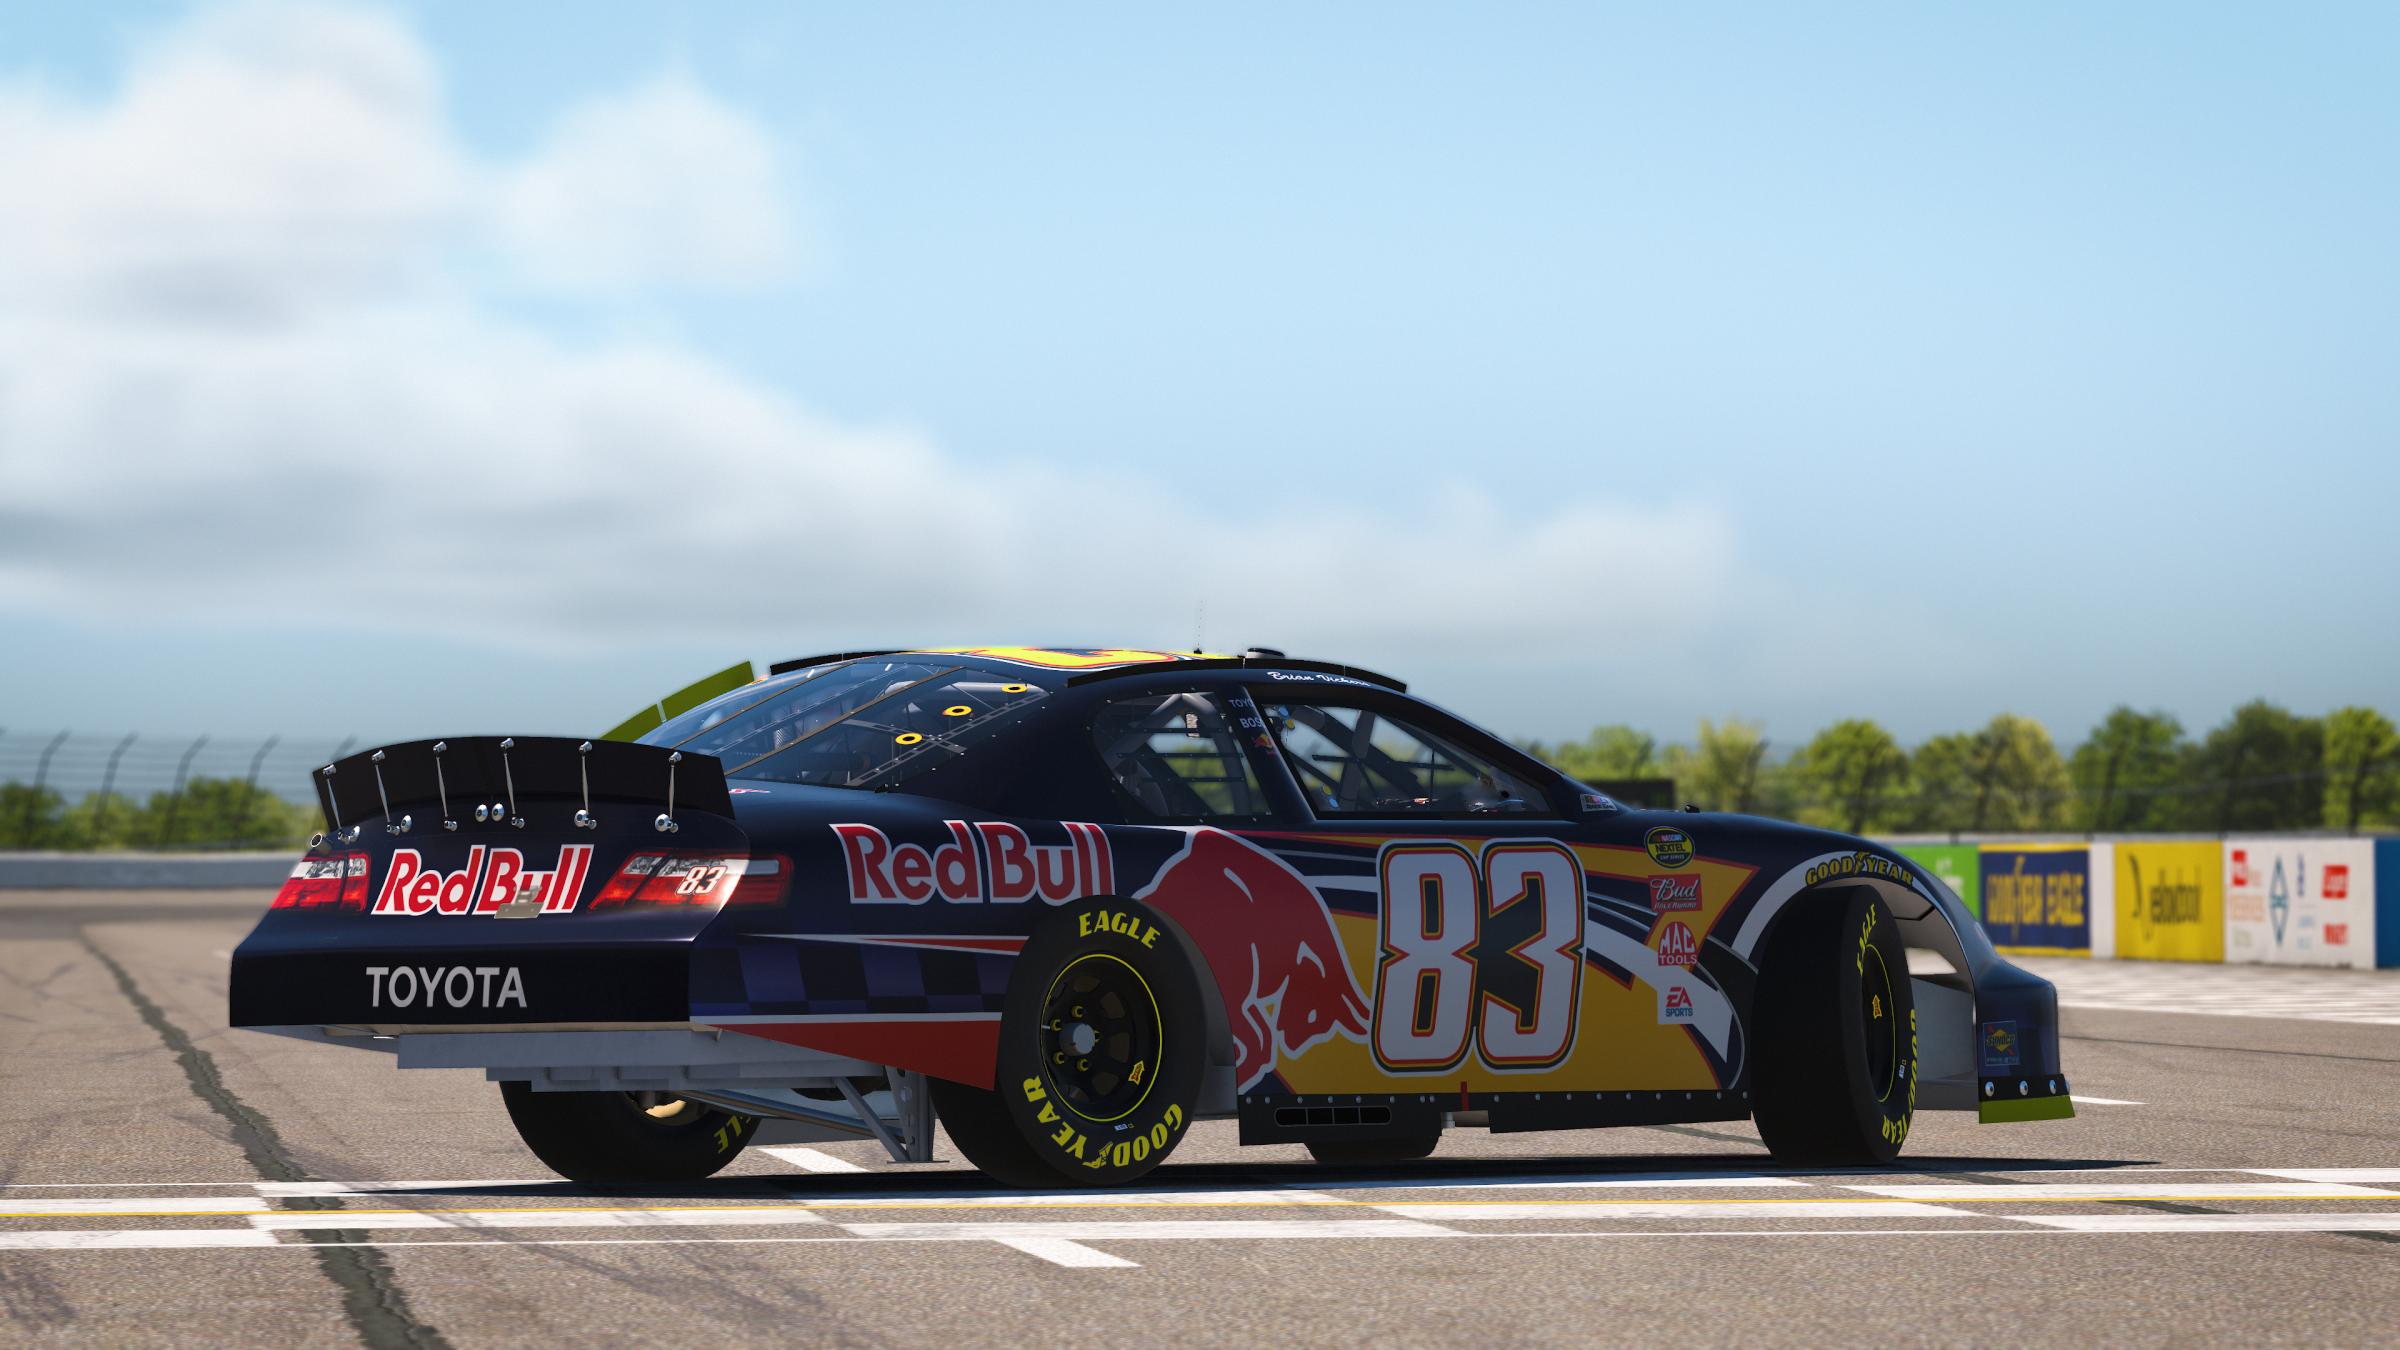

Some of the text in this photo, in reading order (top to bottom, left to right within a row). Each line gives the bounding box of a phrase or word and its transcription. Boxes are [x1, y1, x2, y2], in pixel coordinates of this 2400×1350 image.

[1655, 843, 1687, 853] NEXTEL
[675, 865, 728, 896] 83
[1805, 852, 1914, 888] GOODYEAR
[1650, 878, 1700, 901] Bud
[1079, 910, 1161, 949] EAGLE
[1660, 922, 1696, 954] MAC
[1370, 838, 1587, 1078] 83
[1658, 954, 1698, 965] TOOLS
[366, 966, 528, 1008] TOYOTA
[1666, 986, 1693, 1008] EA
[1666, 1007, 1694, 1017] SPORTS
[1023, 1074, 1183, 1169] GOODYEAR
